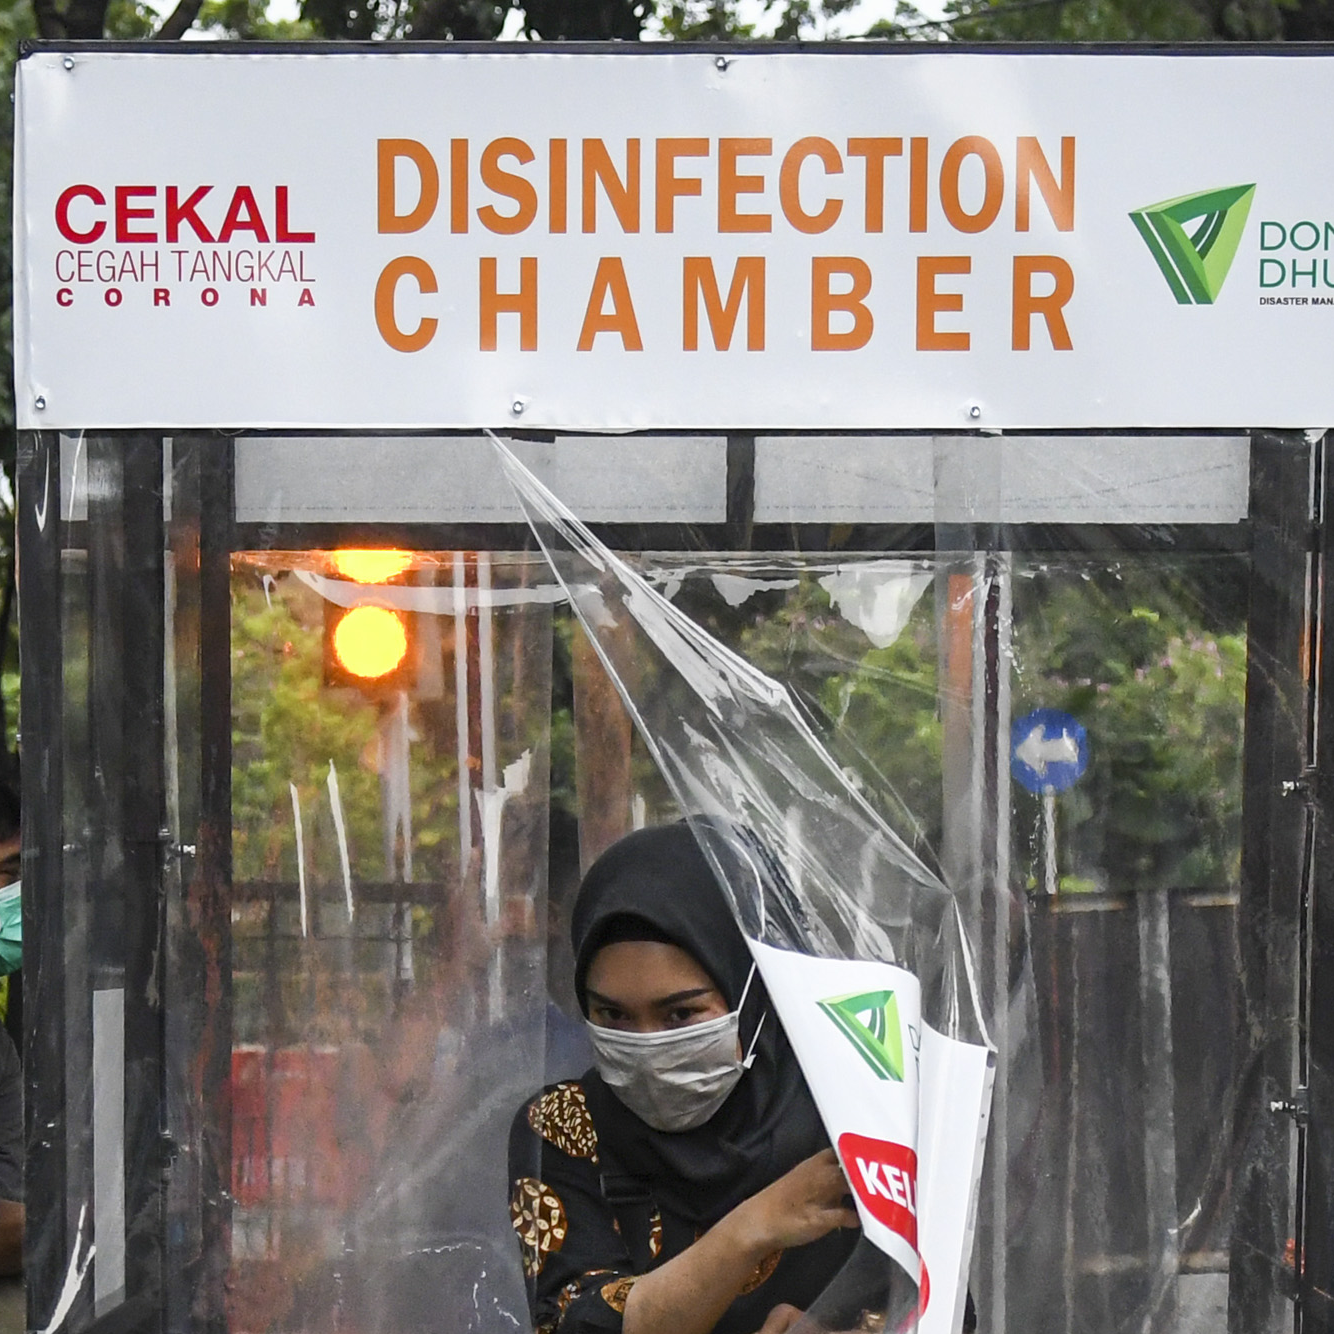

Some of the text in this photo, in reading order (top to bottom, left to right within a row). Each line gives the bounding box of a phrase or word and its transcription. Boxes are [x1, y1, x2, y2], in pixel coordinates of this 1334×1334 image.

[378, 136, 1076, 235] DISINFECTION
[55, 185, 316, 244] CEKAL
[55, 250, 316, 283] CEGAH TANGKAL
[56, 287, 316, 308] CORONA
[374, 255, 1075, 353] CHAMBER
[1259, 297, 1309, 306] DISASTER
